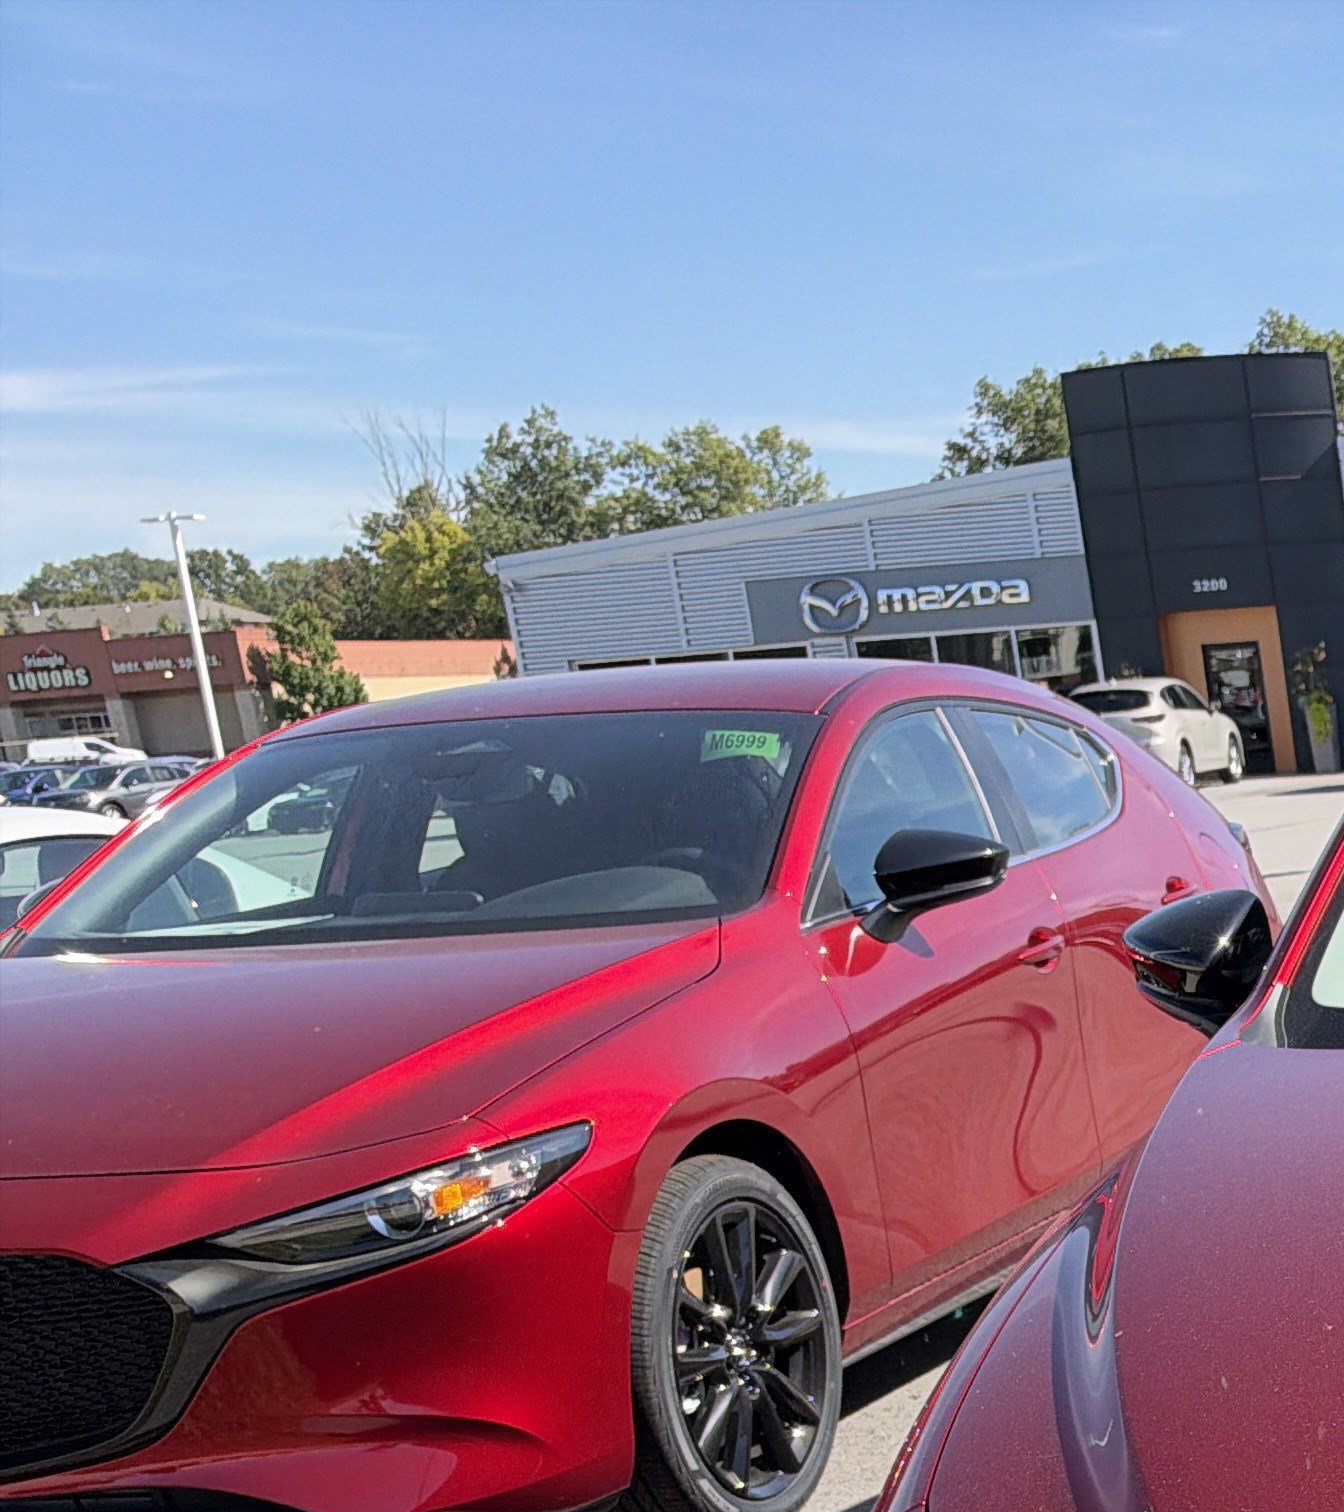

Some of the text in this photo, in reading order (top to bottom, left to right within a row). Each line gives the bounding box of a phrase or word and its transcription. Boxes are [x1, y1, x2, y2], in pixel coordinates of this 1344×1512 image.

[1192, 577, 1228, 593] 3200
[876, 578, 1031, 614] mazda
[7, 667, 89, 692] LIQUORS
[710, 733, 768, 751] M6999
